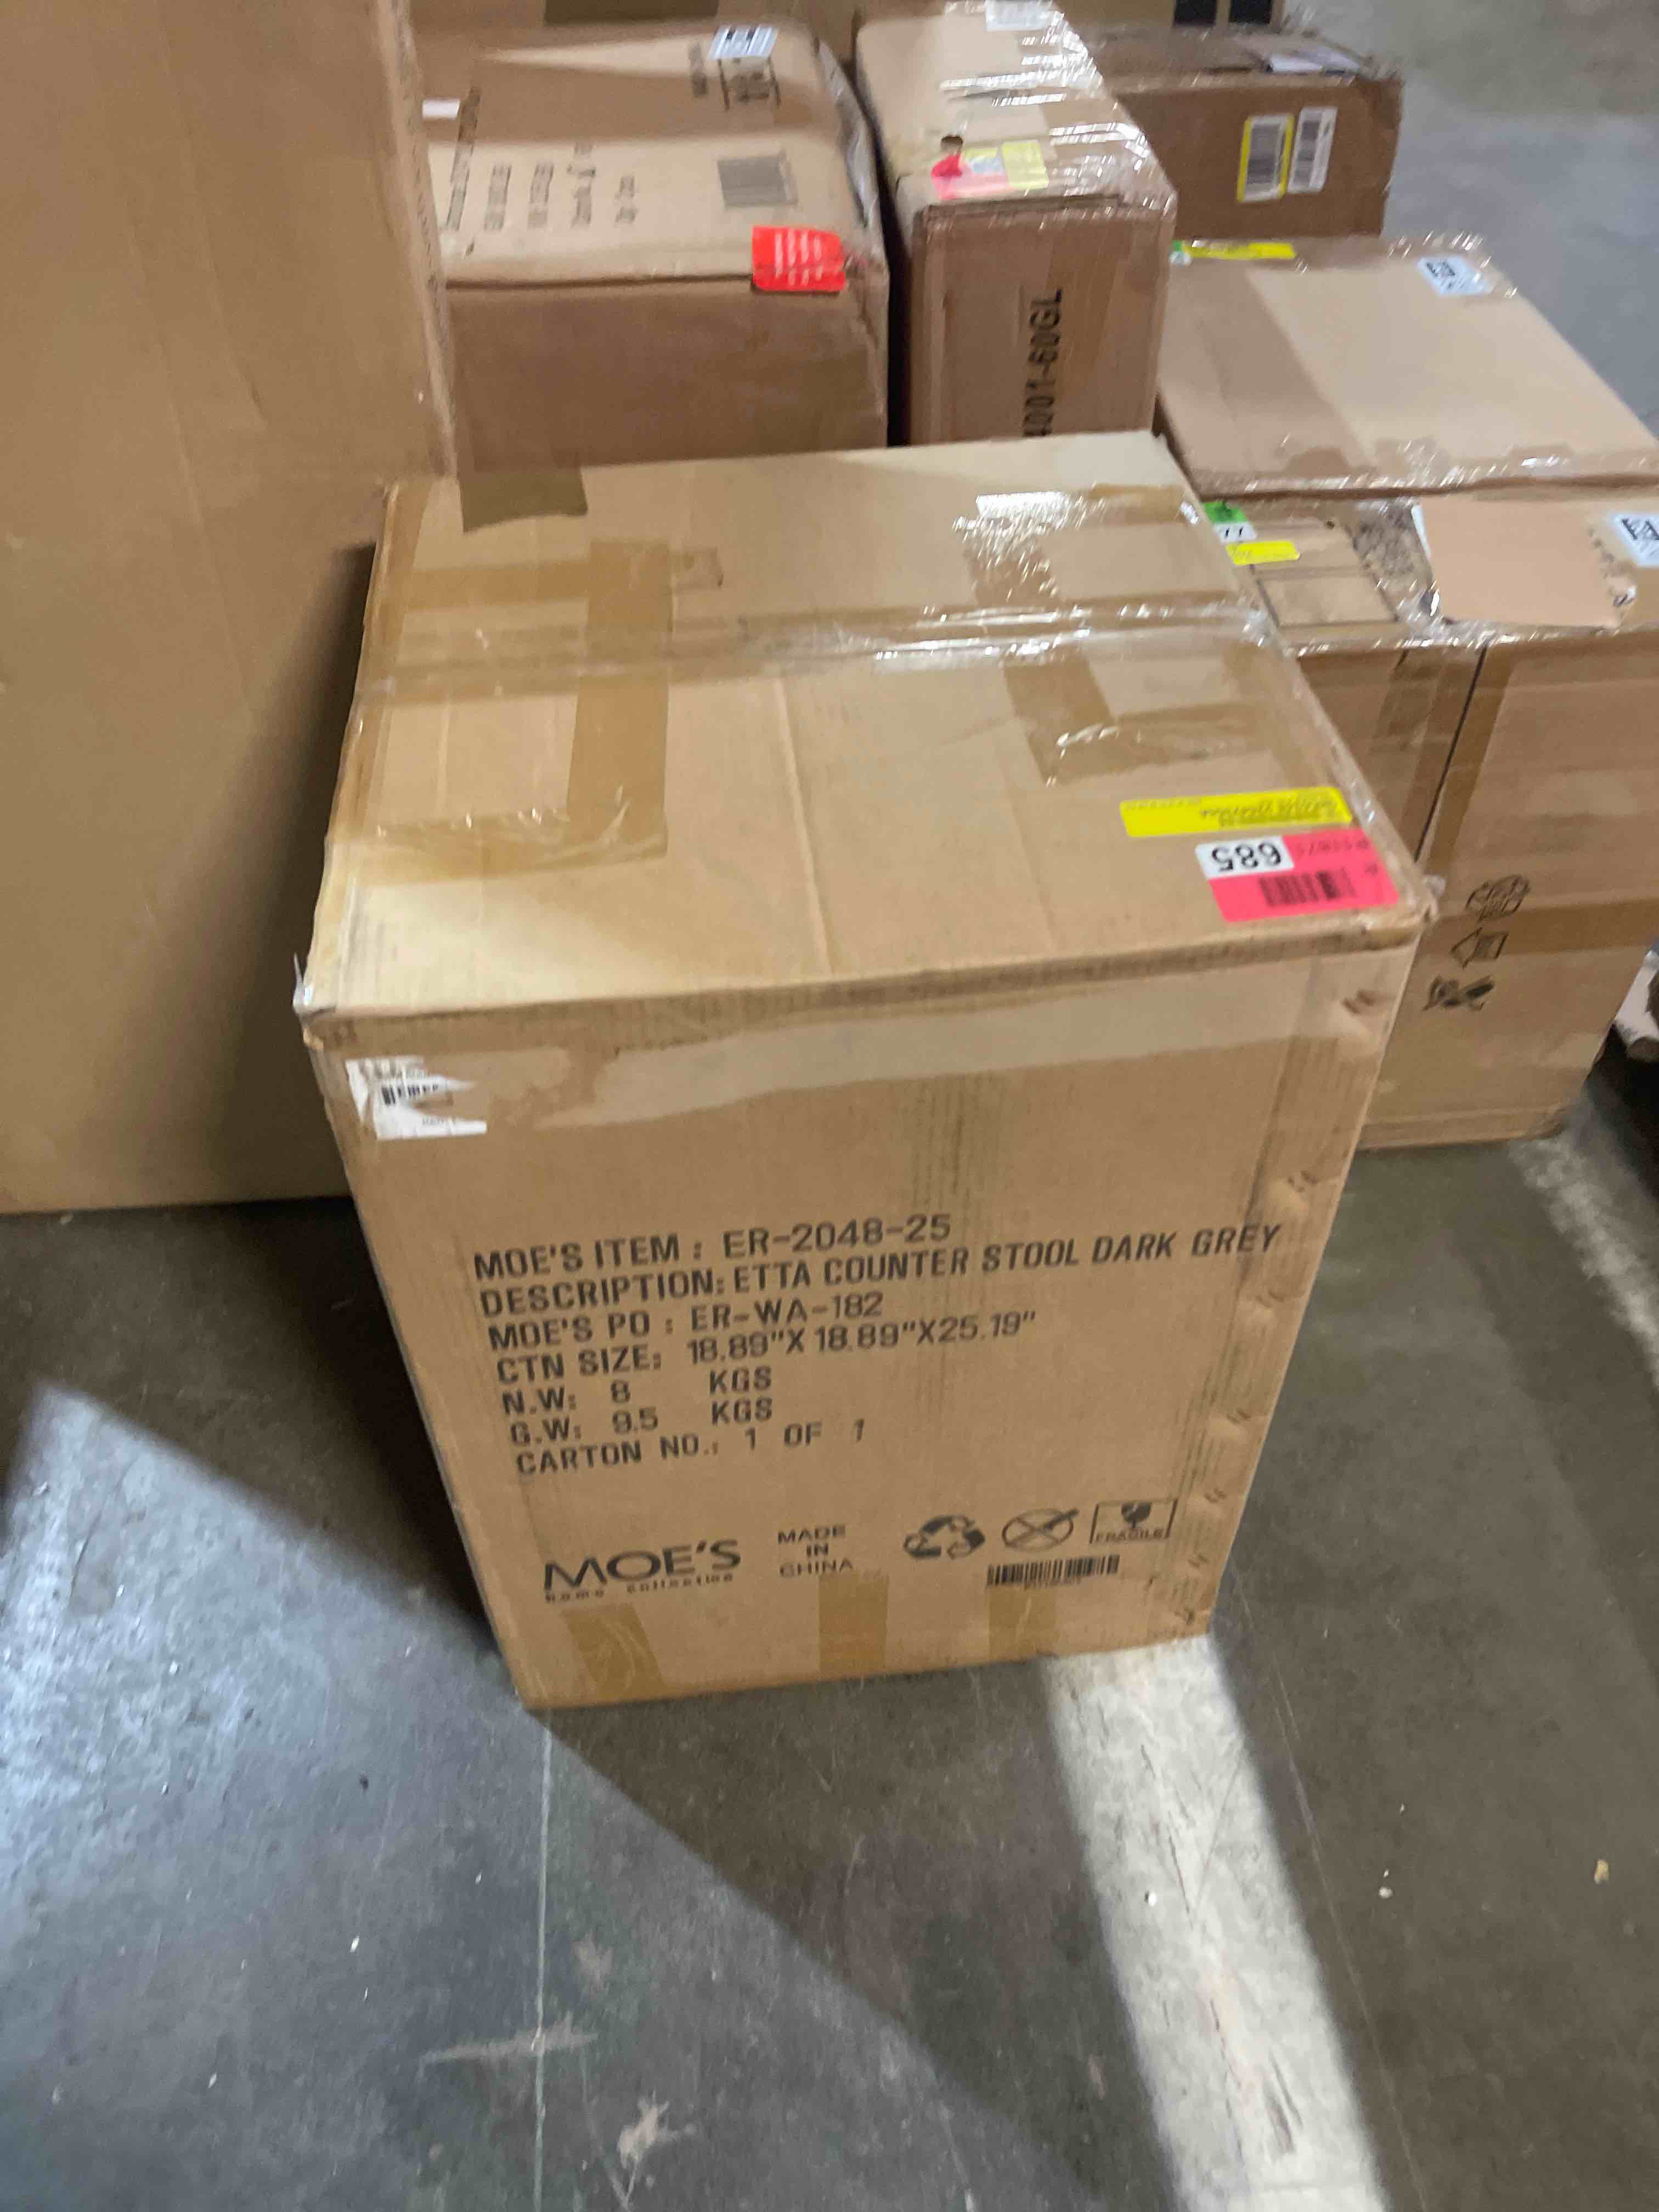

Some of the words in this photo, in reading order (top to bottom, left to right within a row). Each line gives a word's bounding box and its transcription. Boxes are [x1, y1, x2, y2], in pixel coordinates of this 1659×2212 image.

[1211, 842, 1281, 873] 685
[474, 1243, 583, 1280] MOE'S
[595, 1233, 680, 1268] ITEM
[723, 1213, 951, 1260] ER-2048-25
[823, 1246, 969, 1286] COUNTER
[981, 1238, 1079, 1274] STOOL
[1092, 1232, 1178, 1264] DARK
[1191, 1223, 1282, 1257] GREY
[488, 1316, 593, 1351] MOE'S
[608, 1310, 650, 1339] PO
[690, 1291, 883, 1332] ER-WA-182
[496, 1352, 565, 1385] CTN
[577, 1344, 662, 1377] SIZE:
[502, 1388, 577, 1417] N.W:
[610, 1379, 630, 1403] 8
[708, 1366, 772, 1395] KGS
[510, 1418, 582, 1447] G.W:
[612, 1406, 659, 1436] 9.5
[711, 1398, 774, 1425] KGS
[516, 1441, 642, 1476] CARTON
[744, 1429, 757, 1449] 1
[783, 1422, 822, 1447] OF
[853, 1419, 865, 1441] 1
[777, 1524, 847, 1545] MADE
[806, 1544, 829, 1558] IN
[543, 1538, 741, 1591] MOE'S
[778, 1559, 854, 1578] CHINA
